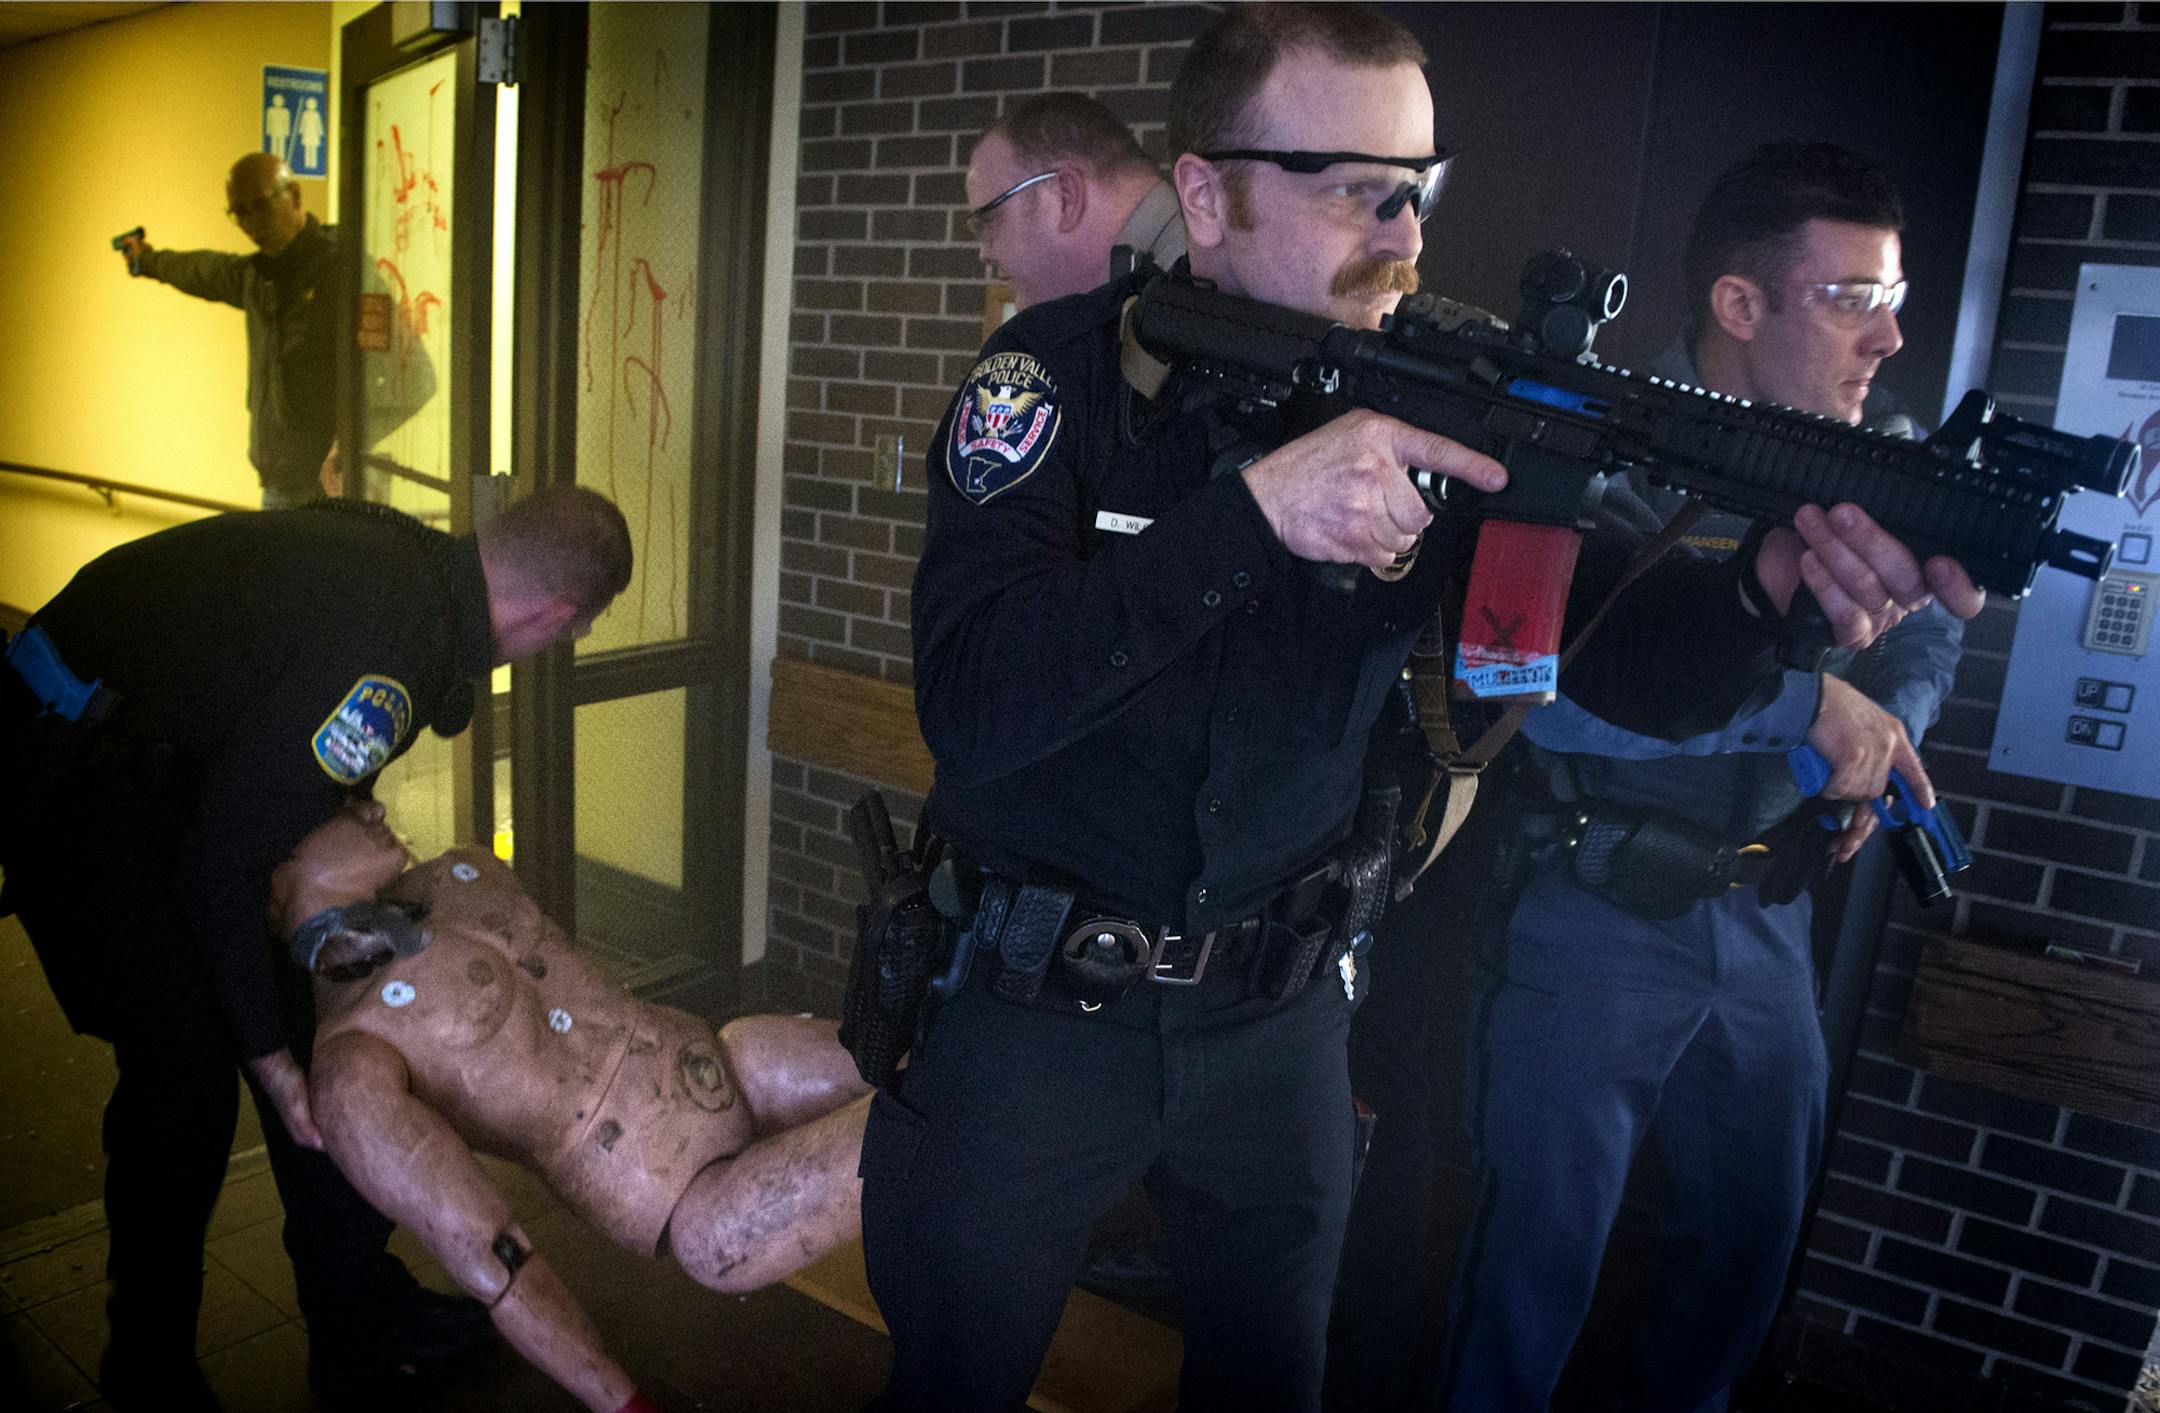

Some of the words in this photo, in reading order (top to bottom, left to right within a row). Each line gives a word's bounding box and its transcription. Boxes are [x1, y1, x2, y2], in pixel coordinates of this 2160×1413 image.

[988, 369, 1034, 389] POLICE
[1019, 411, 1046, 453] SERVICE
[971, 438, 1011, 454] SAFETY
